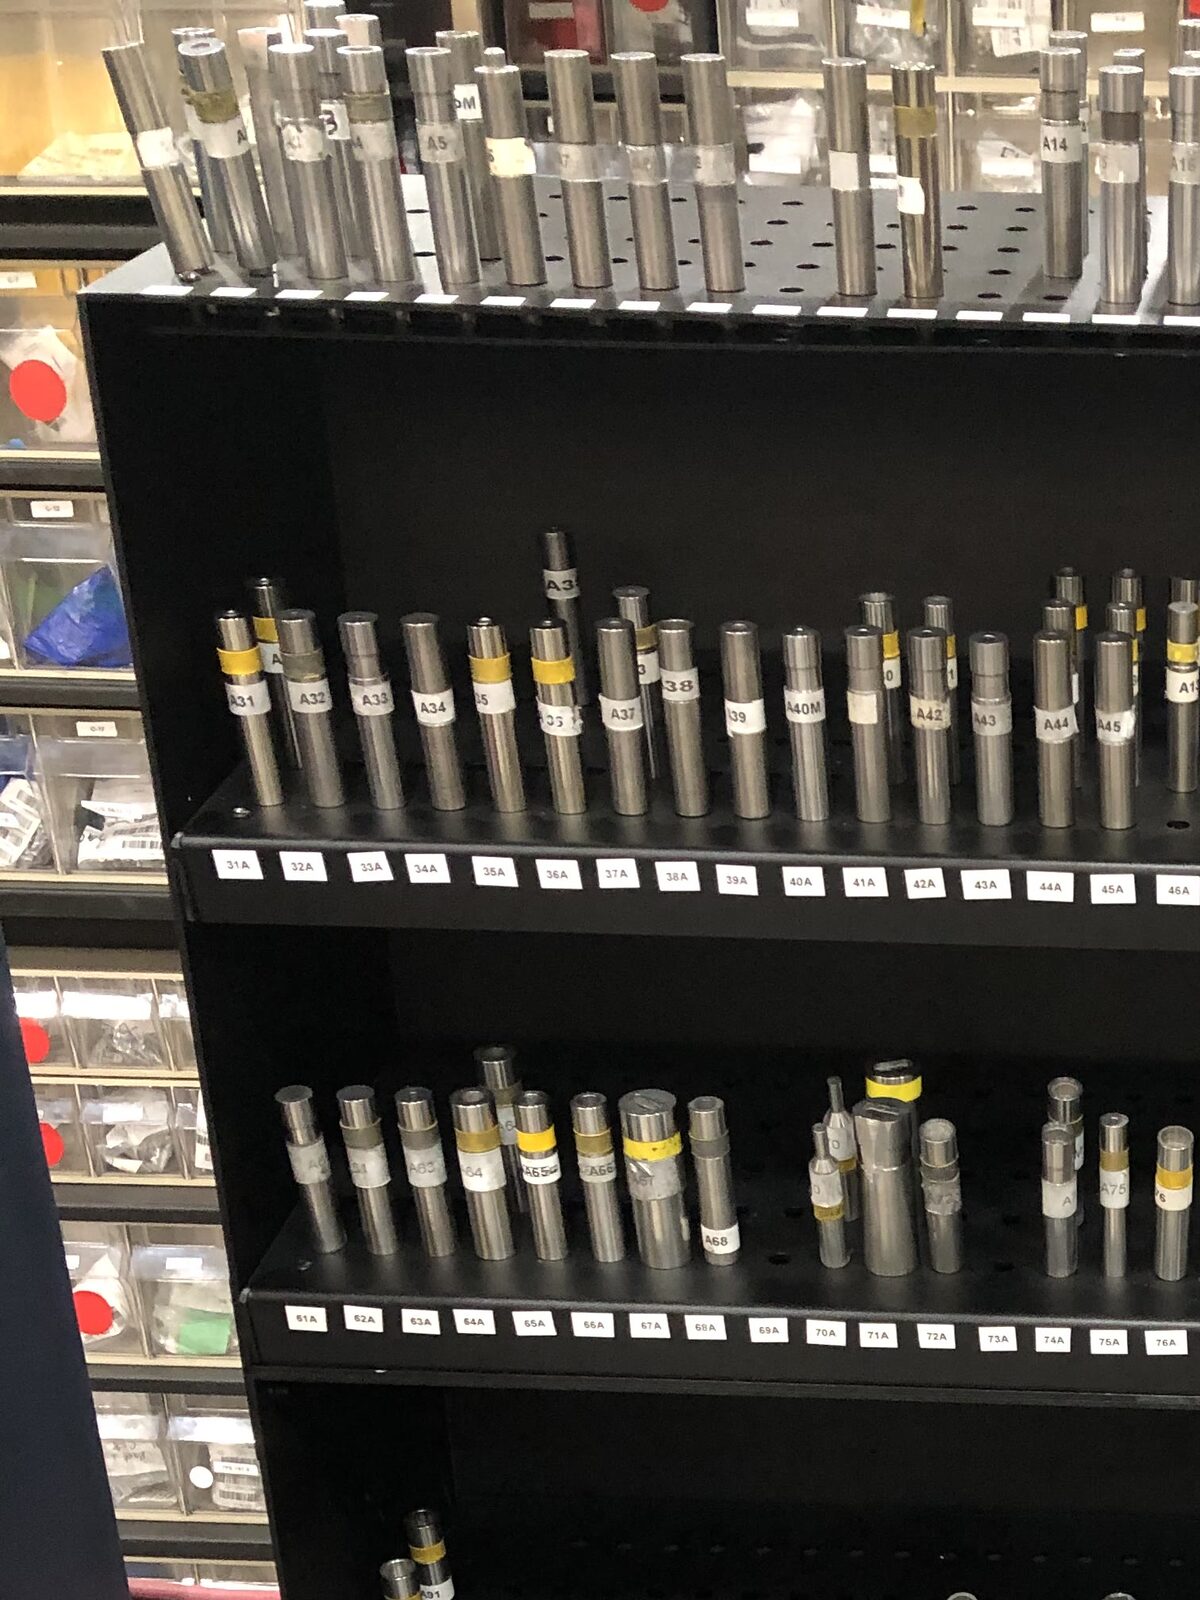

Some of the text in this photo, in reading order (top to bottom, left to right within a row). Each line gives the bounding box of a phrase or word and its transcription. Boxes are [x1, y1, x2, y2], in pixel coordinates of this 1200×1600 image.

[428, 138, 447, 151] A5
[1043, 136, 1068, 151] A14
[229, 693, 255, 708] A31
[300, 692, 325, 705] A32
[362, 692, 388, 706] A33
[420, 701, 447, 715] A34
[786, 702, 821, 716] A40M
[611, 707, 635, 721] A37
[917, 707, 943, 721] A42
[973, 714, 996, 727] A43
[1044, 718, 1070, 731] A44
[1098, 720, 1122, 732] A45
[226, 860, 250, 870] 31A
[291, 862, 314, 872] 32A
[360, 862, 383, 872] 33A
[414, 864, 438, 874] 34A
[483, 867, 506, 877] 35A
[546, 870, 568, 879] 36A
[605, 869, 628, 879] 37A
[666, 872, 688, 882] 38A
[726, 875, 748, 885] 39A
[789, 877, 813, 886] 40A
[853, 878, 876, 887] 41A
[913, 879, 936, 889] 42A
[974, 880, 997, 890] 43A
[1039, 882, 1062, 892] 44A
[1101, 884, 1124, 894] 45A
[1168, 886, 1190, 895] 46A
[1101, 1182, 1127, 1196] A75
[704, 1235, 728, 1247] A68
[354, 1314, 376, 1324] 62A
[410, 1317, 432, 1326] 63A
[524, 1319, 546, 1328] 65A
[583, 1321, 605, 1329] 66A
[641, 1322, 662, 1330] 67A
[695, 1323, 716, 1332] 68A
[759, 1326, 780, 1334] 69A
[815, 1328, 836, 1337] 70A
[867, 1331, 889, 1339] 71A
[926, 1332, 947, 1341] 72A
[988, 1335, 1009, 1344] 73A
[1044, 1336, 1065, 1344] 74A
[1099, 1338, 1120, 1346] 75A
[1156, 1339, 1176, 1347] 76A
